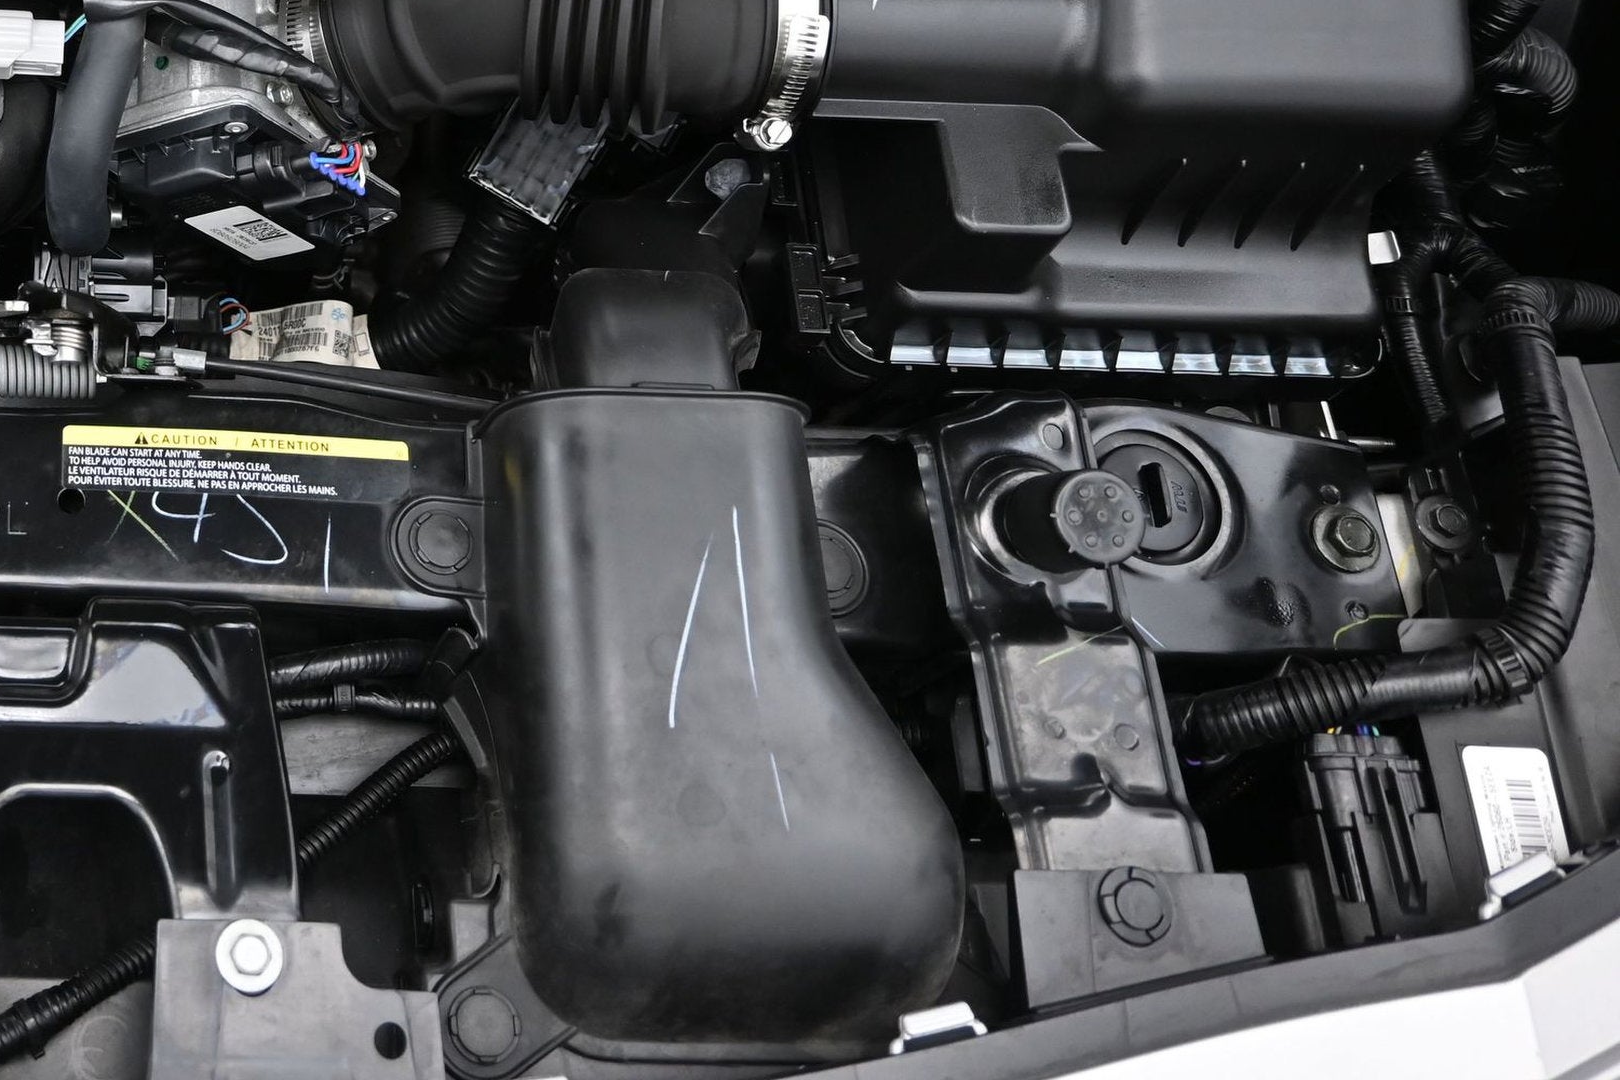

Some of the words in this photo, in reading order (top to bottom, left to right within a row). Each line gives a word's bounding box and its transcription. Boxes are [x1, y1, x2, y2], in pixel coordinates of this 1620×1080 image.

[151, 433, 218, 446] CAUTION
[251, 438, 330, 452] ATTENTION
[68, 447, 84, 456] FAN
[85, 448, 110, 457] BLADE
[111, 448, 128, 457] CAN
[129, 448, 153, 457] START
[153, 449, 164, 457] AT
[164, 449, 182, 458] ANY
[182, 450, 202, 459] TIME.
[69, 456, 80, 465] TO
[80, 457, 101, 466] HELP
[101, 457, 127, 467] AVOID
[127, 458, 168, 468] PERSONAL
[168, 459, 197, 469] INJURY,
[198, 460, 216, 469] KEEP
[219, 461, 245, 471] HANDS
[246, 462, 272, 472] CLEAR.
[68, 466, 79, 475] LE
[79, 467, 135, 477] VENTILATEUR
[136, 468, 168, 478] RISQUE
[169, 470, 181, 478] DE
[182, 468, 229, 479] DÉMARRER
[229, 470, 237, 480] À
[236, 472, 260, 481] TOUT
[261, 473, 302, 484] MOMENT.
[68, 476, 93, 485] POUR
[94, 475, 123, 486] ÉVITER
[123, 477, 152, 487] TOUTE
[152, 478, 196, 489] BLESSURE,
[197, 480, 209, 489] NE
[210, 480, 227, 490] PAS
[227, 481, 240, 490] EN
[241, 482, 292, 493] APPROCHER
[292, 484, 307, 494] LES
[308, 485, 338, 496] MAINS.
